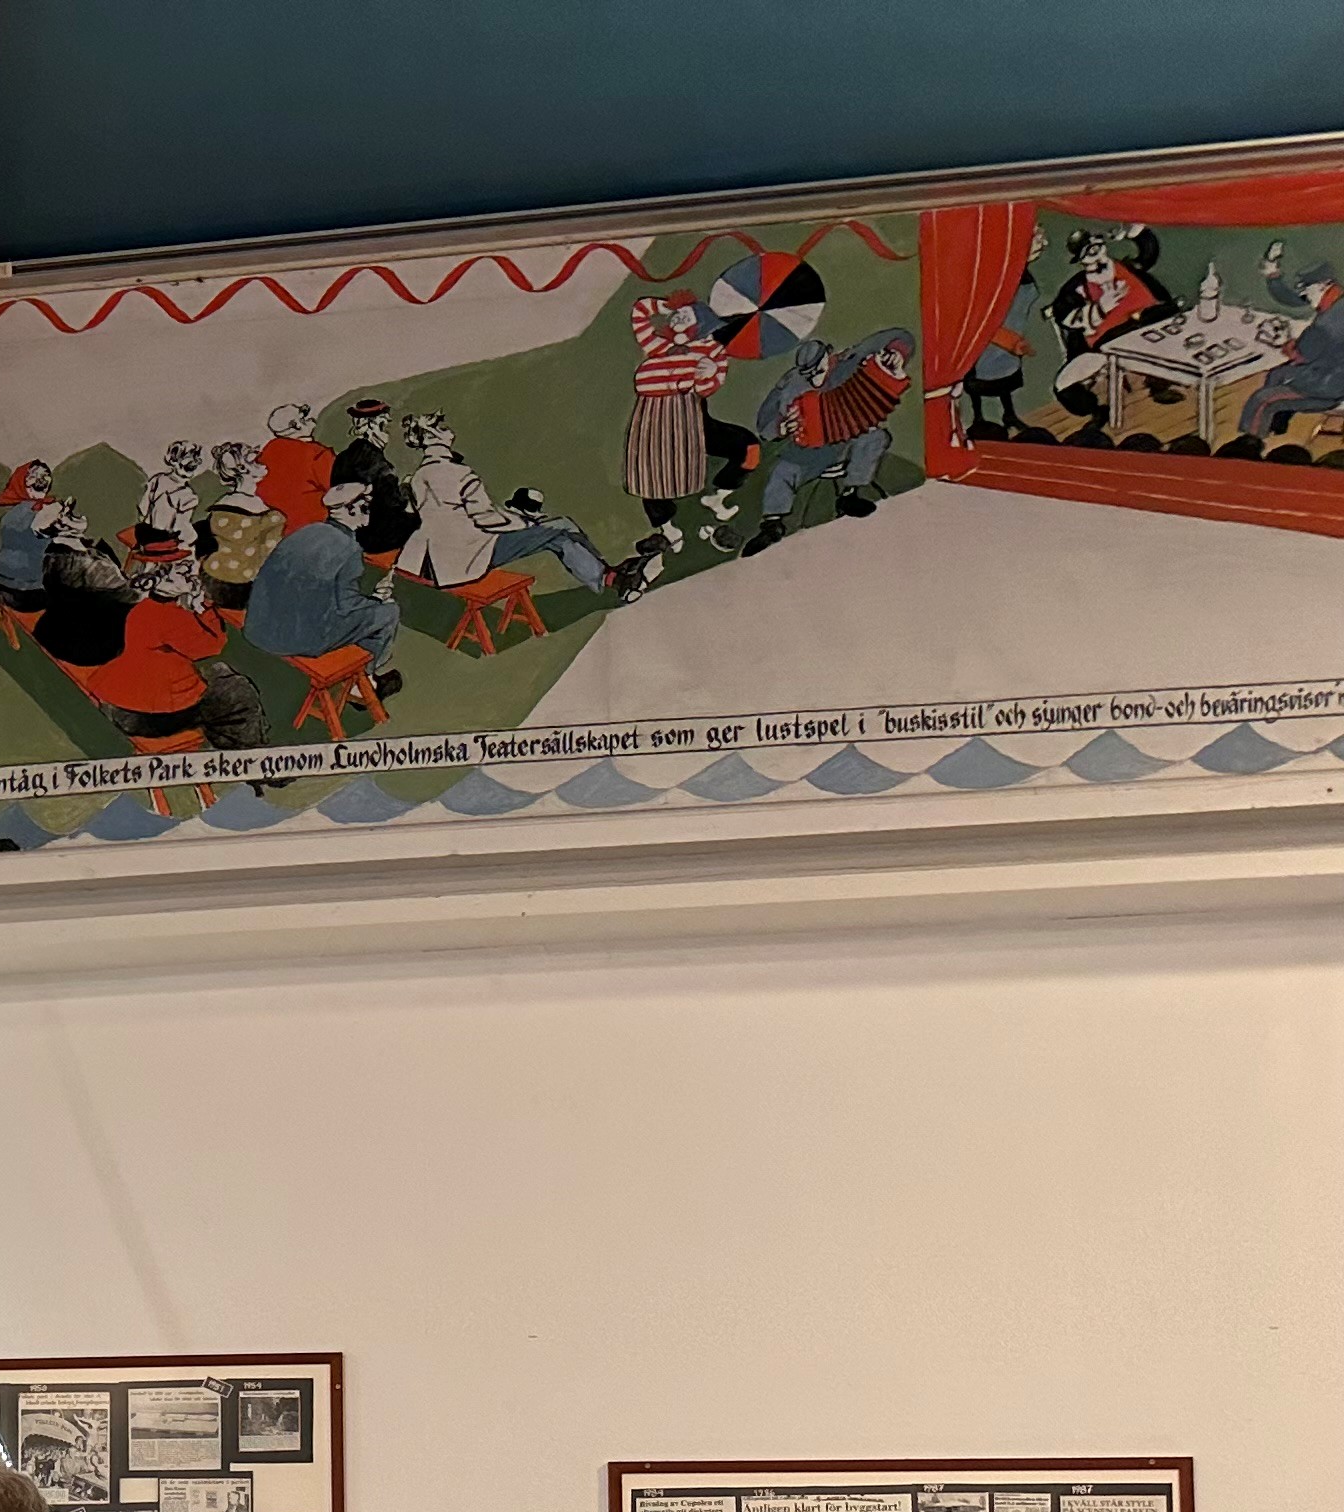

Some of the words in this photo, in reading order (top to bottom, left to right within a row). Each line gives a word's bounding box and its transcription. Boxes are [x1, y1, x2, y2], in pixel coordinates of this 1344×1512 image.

[52, 765, 60, 790] i
[63, 762, 143, 788] Folkets
[148, 756, 198, 782] Park
[204, 751, 258, 777] sker
[260, 754, 324, 779] genom
[330, 739, 470, 770] Lundholmska
[651, 729, 695, 747] som
[706, 724, 745, 750] ger
[756, 713, 851, 743] lustspel
[858, 711, 866, 735] i
[995, 702, 1027, 729] och
[1032, 699, 1104, 732] sjunger
[794, 1501, 821, 1512] klart
[825, 1501, 842, 1512] för
